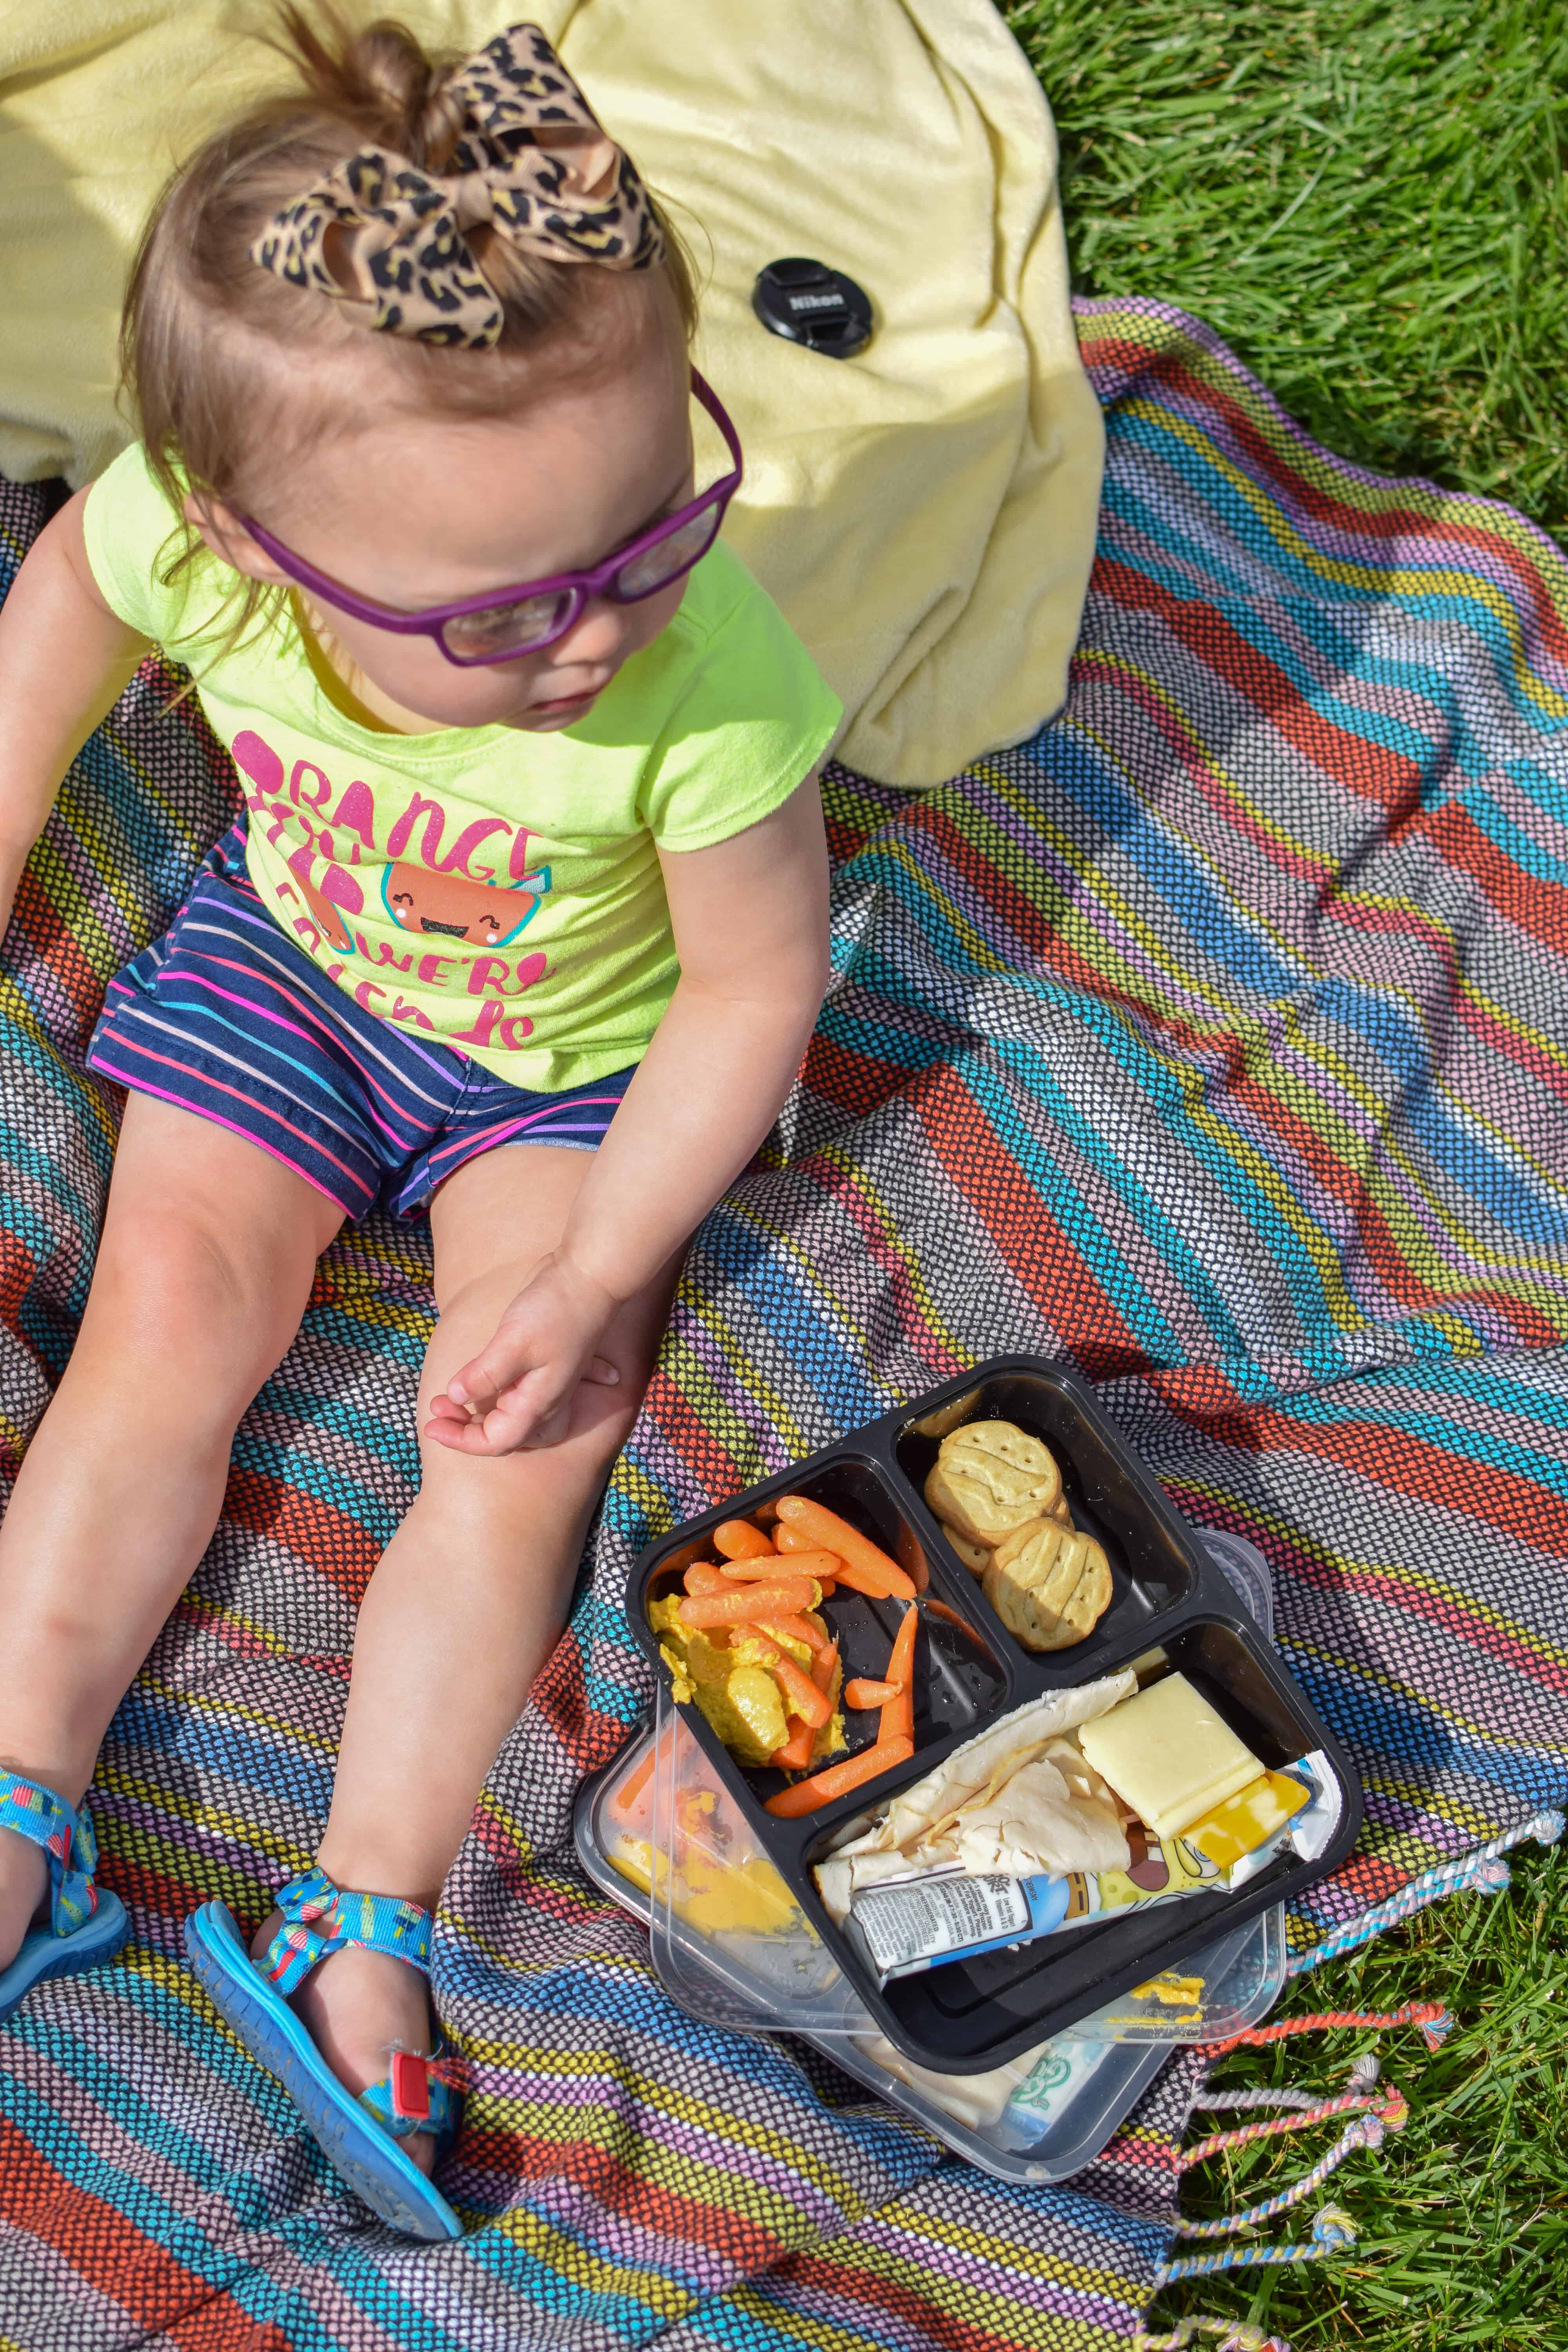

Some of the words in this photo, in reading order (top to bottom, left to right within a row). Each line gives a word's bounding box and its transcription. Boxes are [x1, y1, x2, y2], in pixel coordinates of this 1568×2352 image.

[789, 294, 844, 310] Nikon
[975, 1888, 985, 1902] years
[920, 1895, 939, 1931] REFRIGERATED
[941, 1908, 950, 1924] Yoplait
[955, 1886, 963, 1897] thaw
[960, 1898, 971, 1915] before
[967, 1915, 975, 1938] serving.
[967, 1884, 982, 1911] swallowing
[979, 1912, 987, 1930] frozen
[967, 1899, 978, 1918] Yogurt.
[995, 1898, 1004, 1916] Vitamins
[906, 1896, 916, 1910] THAW
[913, 1909, 921, 1920] AND
[917, 1919, 929, 1945] REFREEZE
[914, 1898, 928, 1920] PRODUCT
[924, 1920, 935, 1944] QUALITY
[1006, 1913, 1016, 1927] Yogurt
[885, 1941, 894, 1955] Viacom
[893, 1928, 906, 1950] SpongeBob
